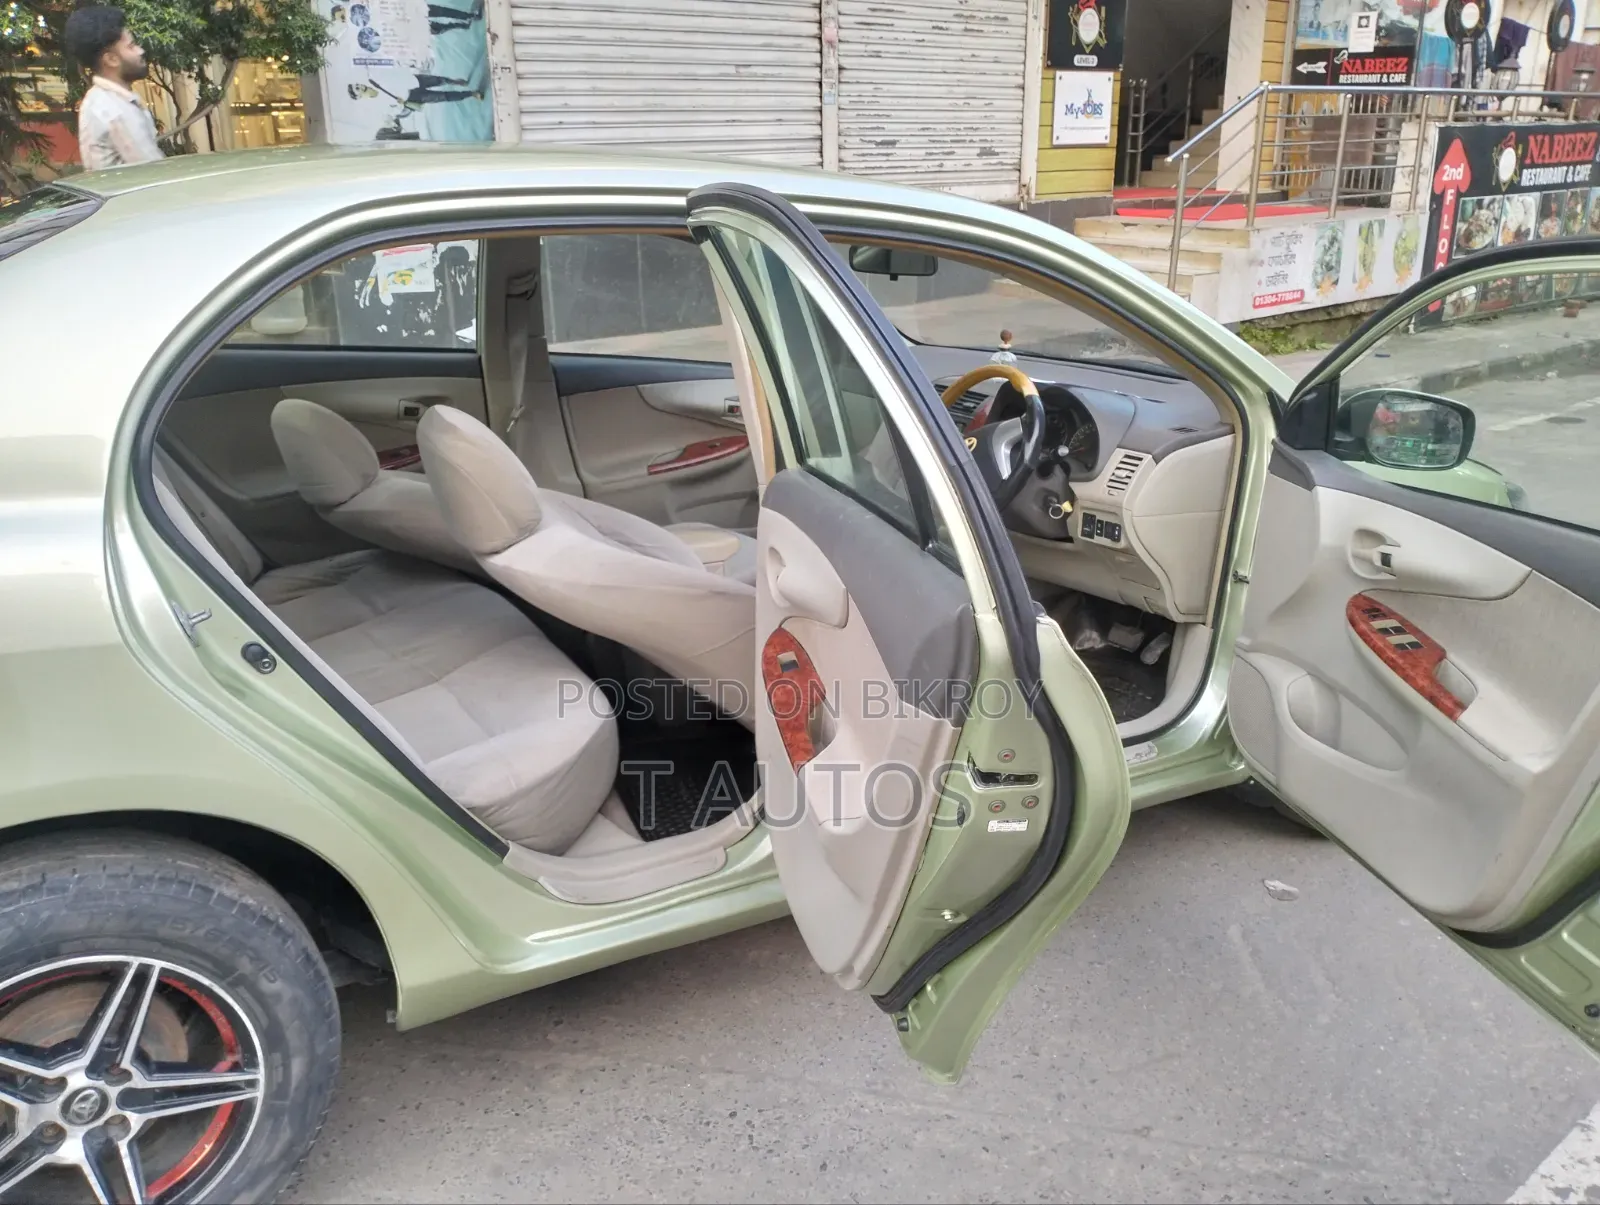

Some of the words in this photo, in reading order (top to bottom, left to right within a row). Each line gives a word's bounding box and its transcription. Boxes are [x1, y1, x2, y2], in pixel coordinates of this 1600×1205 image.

[1340, 57, 1409, 73] NABEEZ
[1339, 73, 1381, 83] RESTAURANT
[1381, 73, 1388, 83] &
[1389, 73, 1407, 83] CAFE
[1524, 132, 1598, 164] NABEEZ
[1442, 163, 1464, 182] 2nd
[1521, 166, 1567, 187] RESTAURANT
[1573, 164, 1592, 182] CAFE
